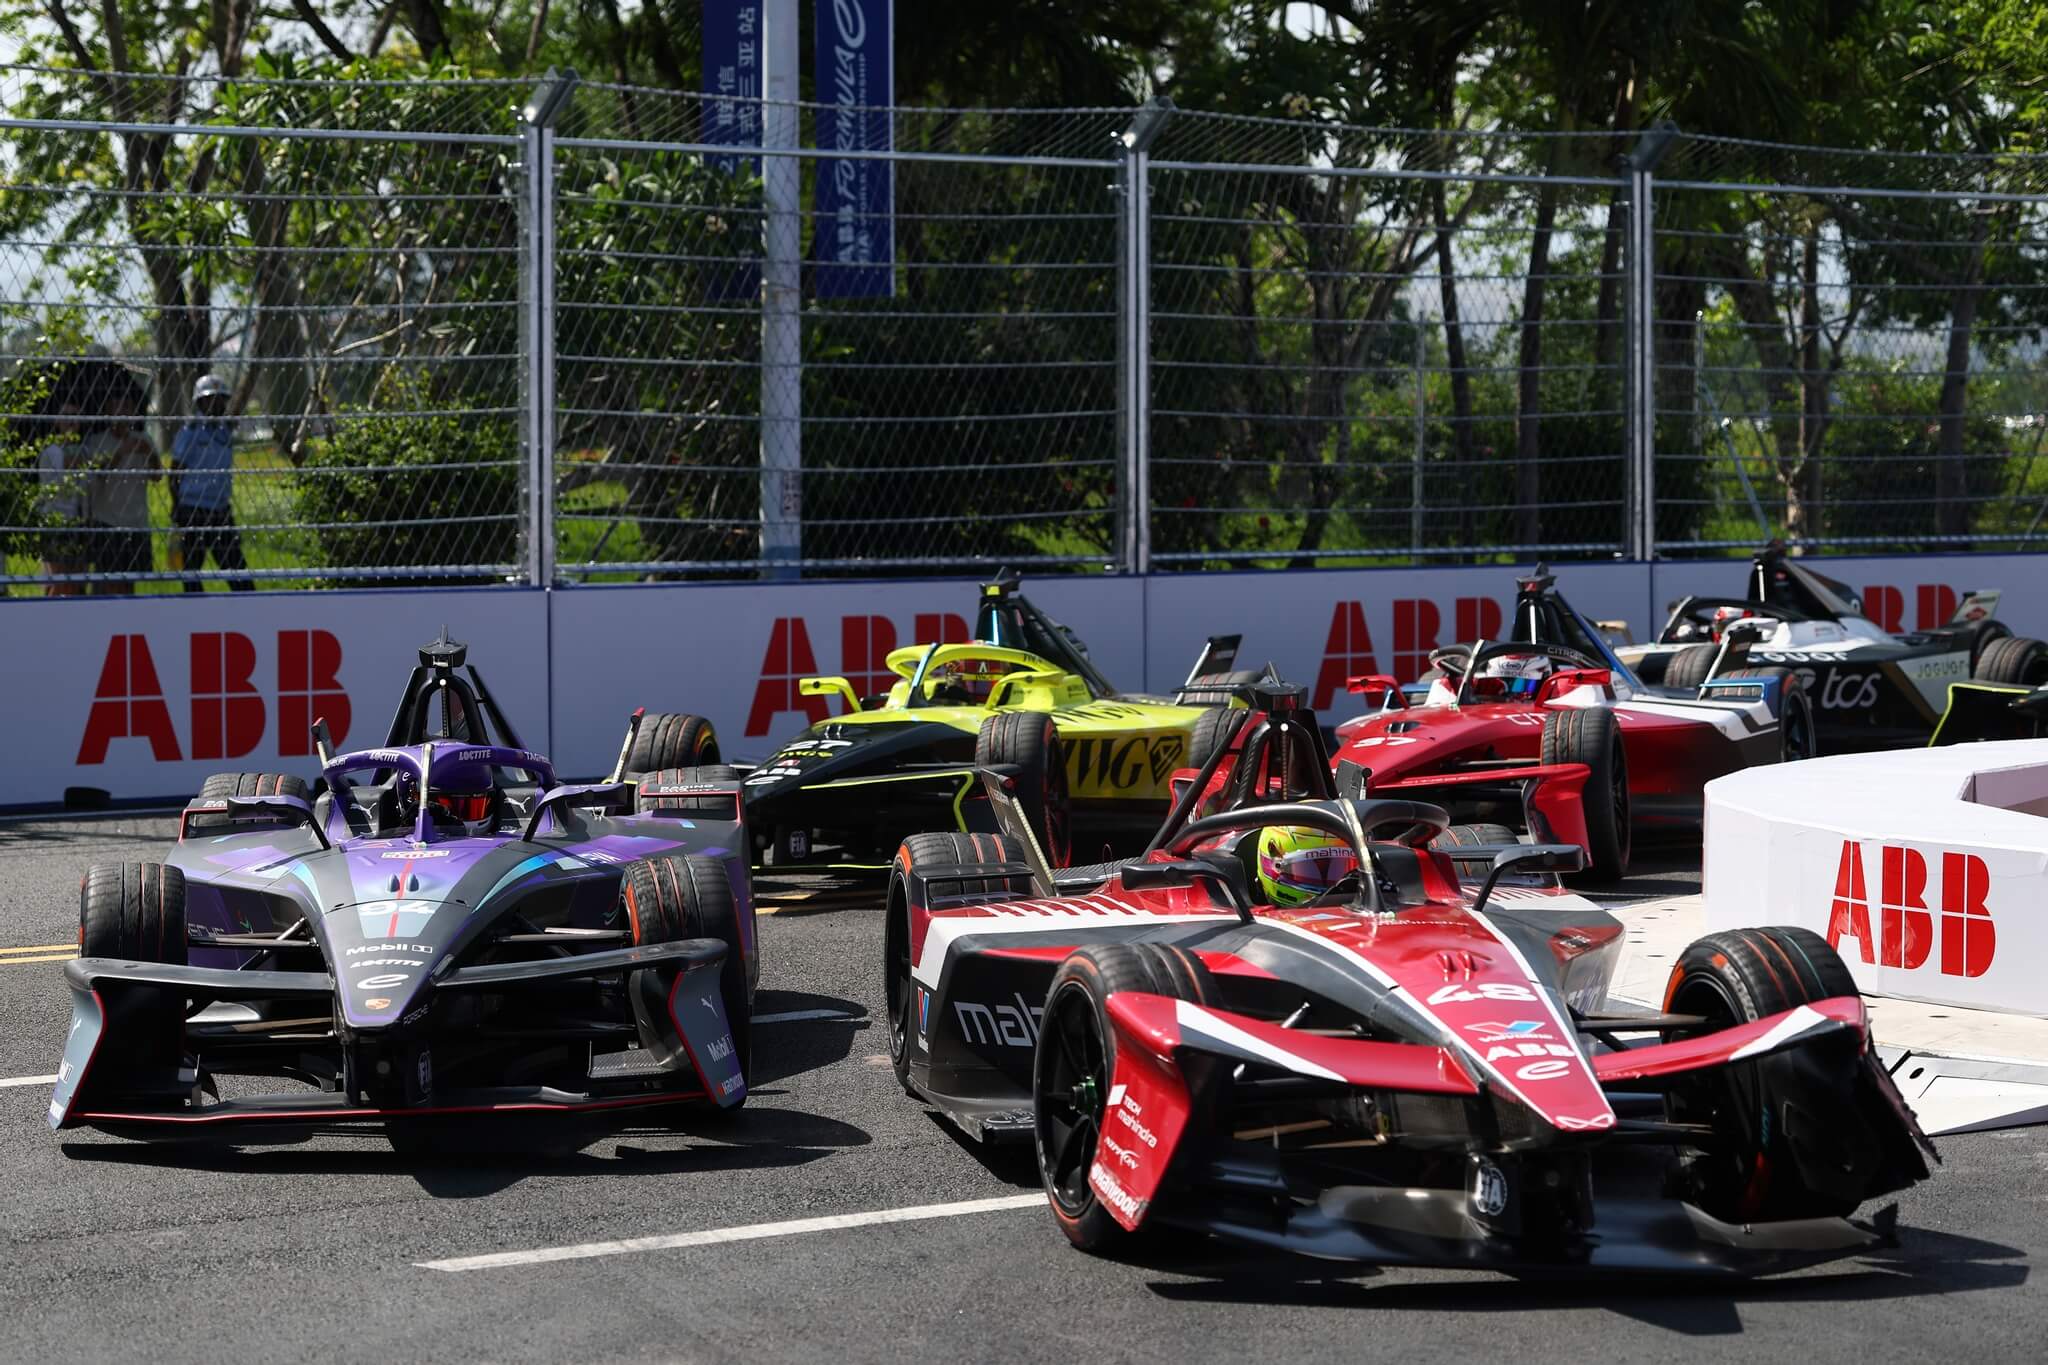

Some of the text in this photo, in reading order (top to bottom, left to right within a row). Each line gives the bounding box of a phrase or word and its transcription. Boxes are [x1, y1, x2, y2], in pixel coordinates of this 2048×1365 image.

[834, 45, 856, 200] FORMULA
[858, 53, 868, 168] CAMPIONSHIP
[837, 204, 855, 264] ABB
[76, 628, 352, 765] ABB
[1821, 666, 1881, 710] tcs
[369, 751, 400, 763] LOCTITE
[458, 749, 492, 761] LOCTITE
[1305, 847, 1356, 859] mahin
[1825, 839, 1997, 978] ABB
[346, 943, 408, 956] Mobil
[1427, 983, 1538, 1006] 48
[1486, 1043, 1577, 1062] ABB
[1117, 1108, 1159, 1149] mahindra
